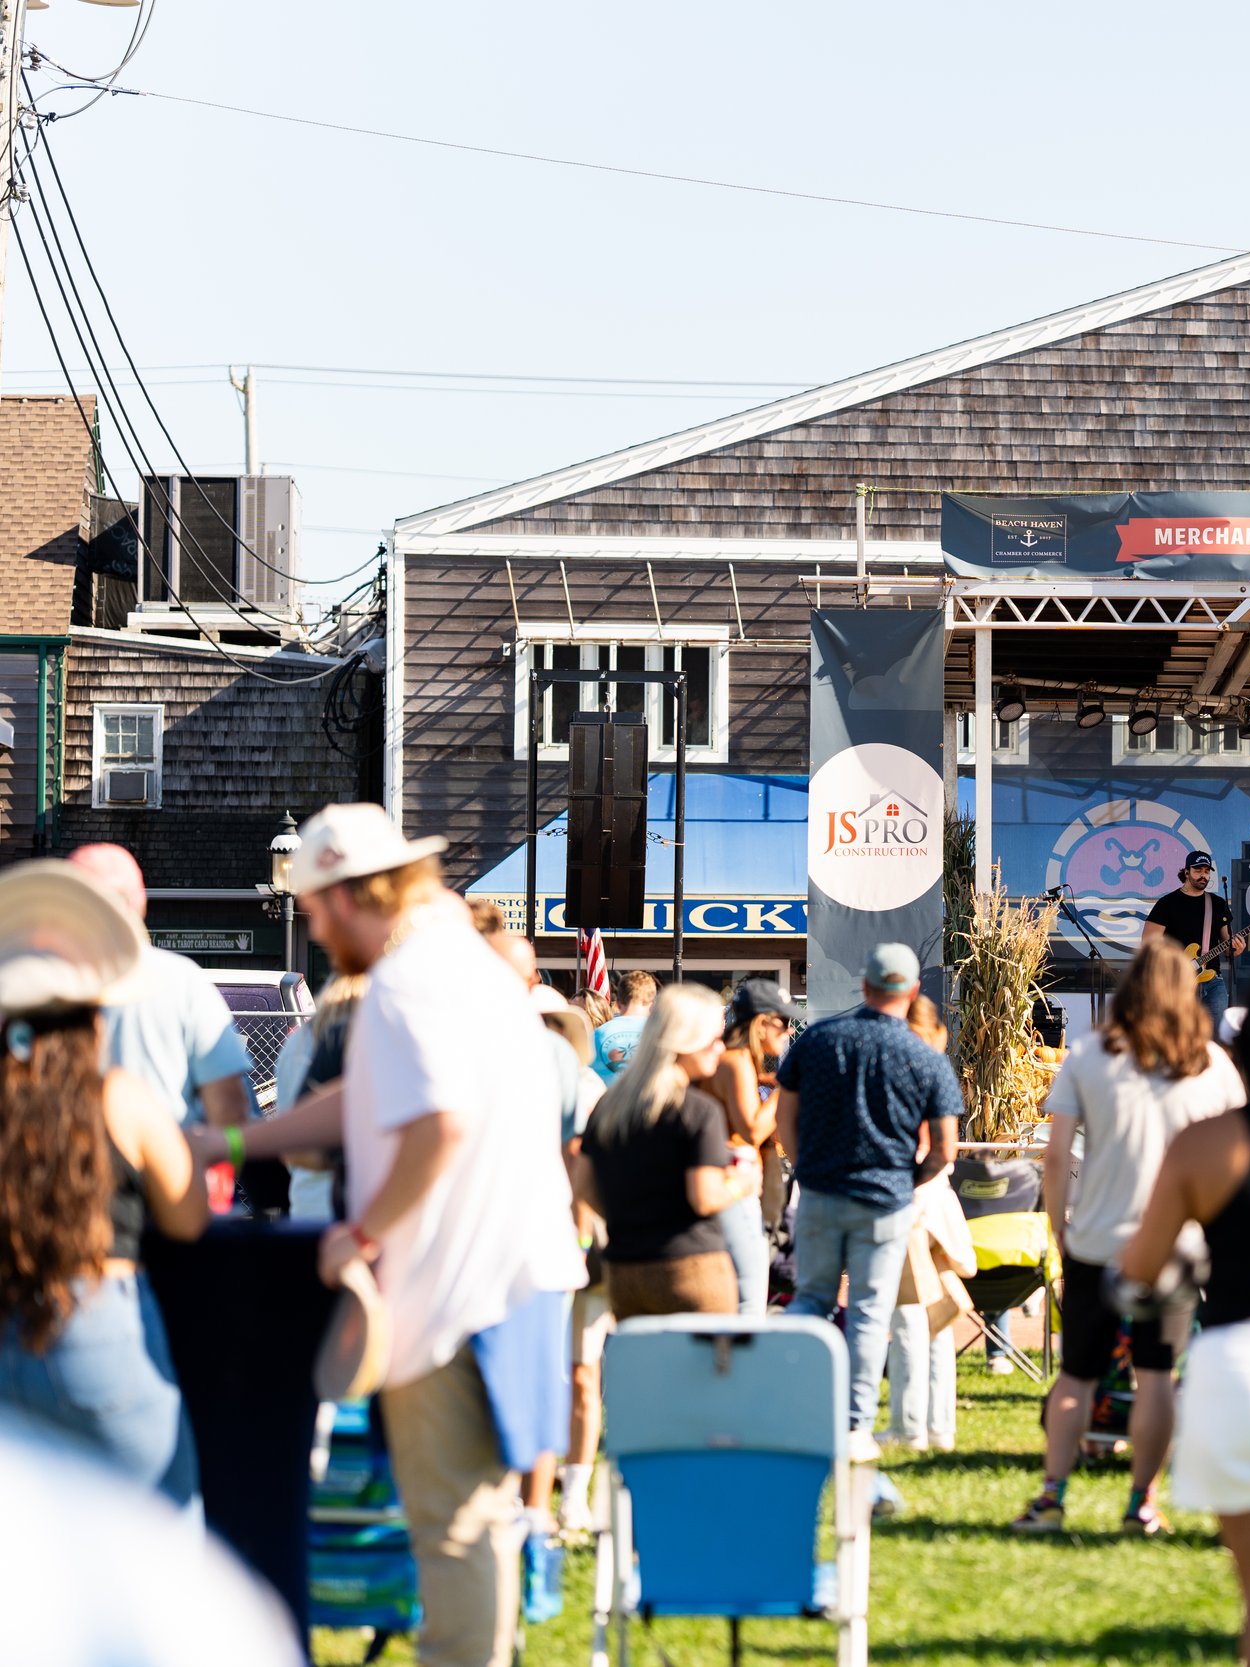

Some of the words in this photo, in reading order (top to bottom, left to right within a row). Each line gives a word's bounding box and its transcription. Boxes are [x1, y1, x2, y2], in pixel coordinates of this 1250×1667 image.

[995, 519, 1027, 527] BEACH
[1031, 520, 1063, 528] HAVEN
[824, 811, 857, 855] JS
[864, 818, 928, 844] PRO
[834, 847, 928, 857] CONSTRUCTION
[177, 940, 193, 948] TAROT
[194, 940, 208, 948] CARD
[209, 940, 234, 949] READINGS
